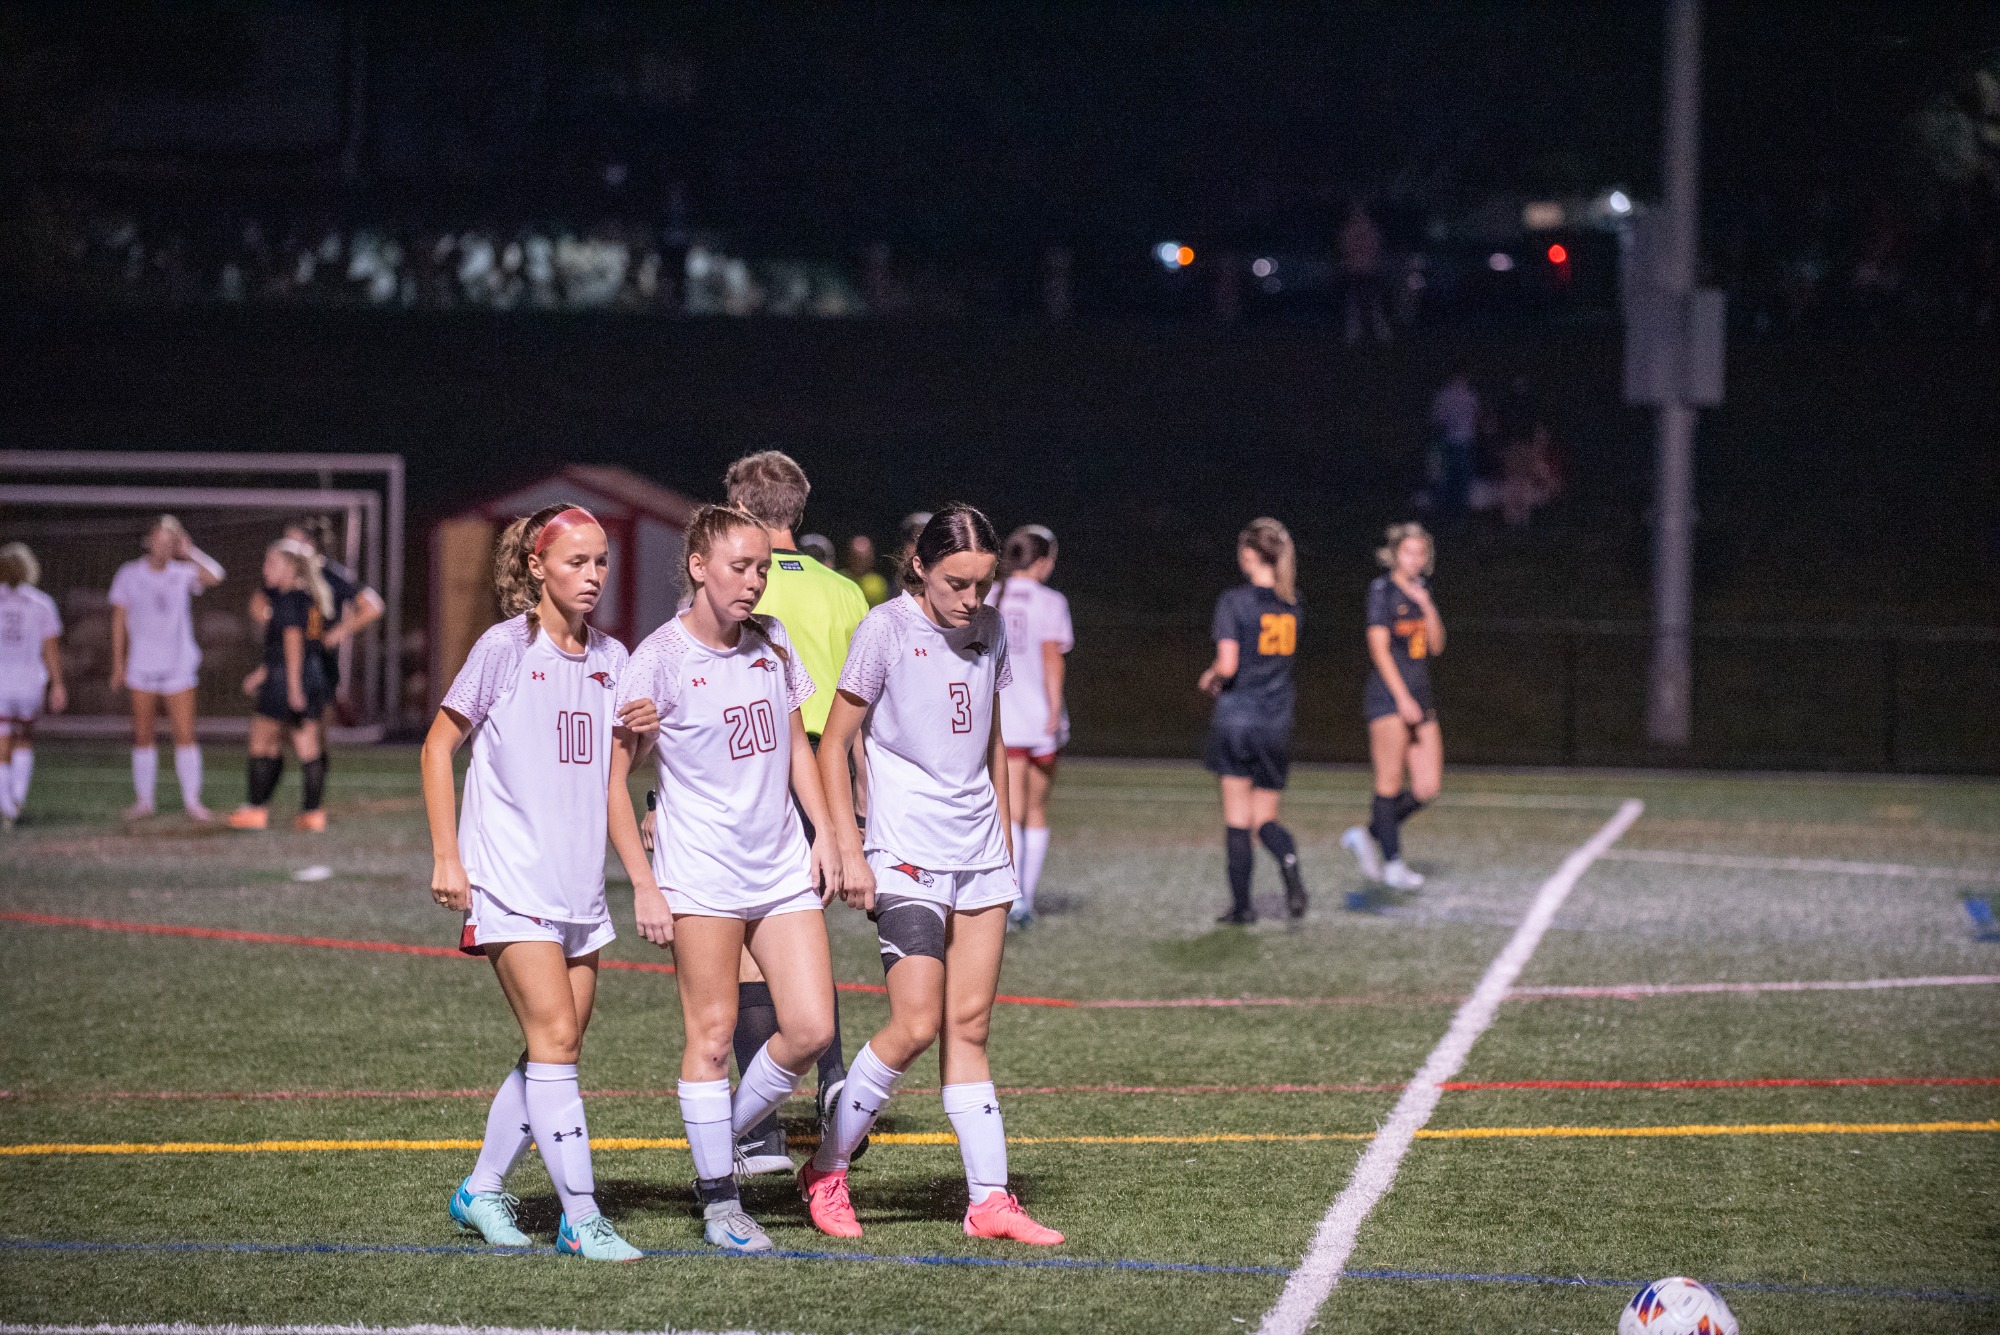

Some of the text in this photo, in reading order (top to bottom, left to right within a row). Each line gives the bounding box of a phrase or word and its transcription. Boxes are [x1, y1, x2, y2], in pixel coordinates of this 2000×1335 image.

[1258, 613, 1297, 656] 20
[723, 698, 777, 760] 20
[948, 682, 972, 734] 3
[556, 710, 593, 764] 10
